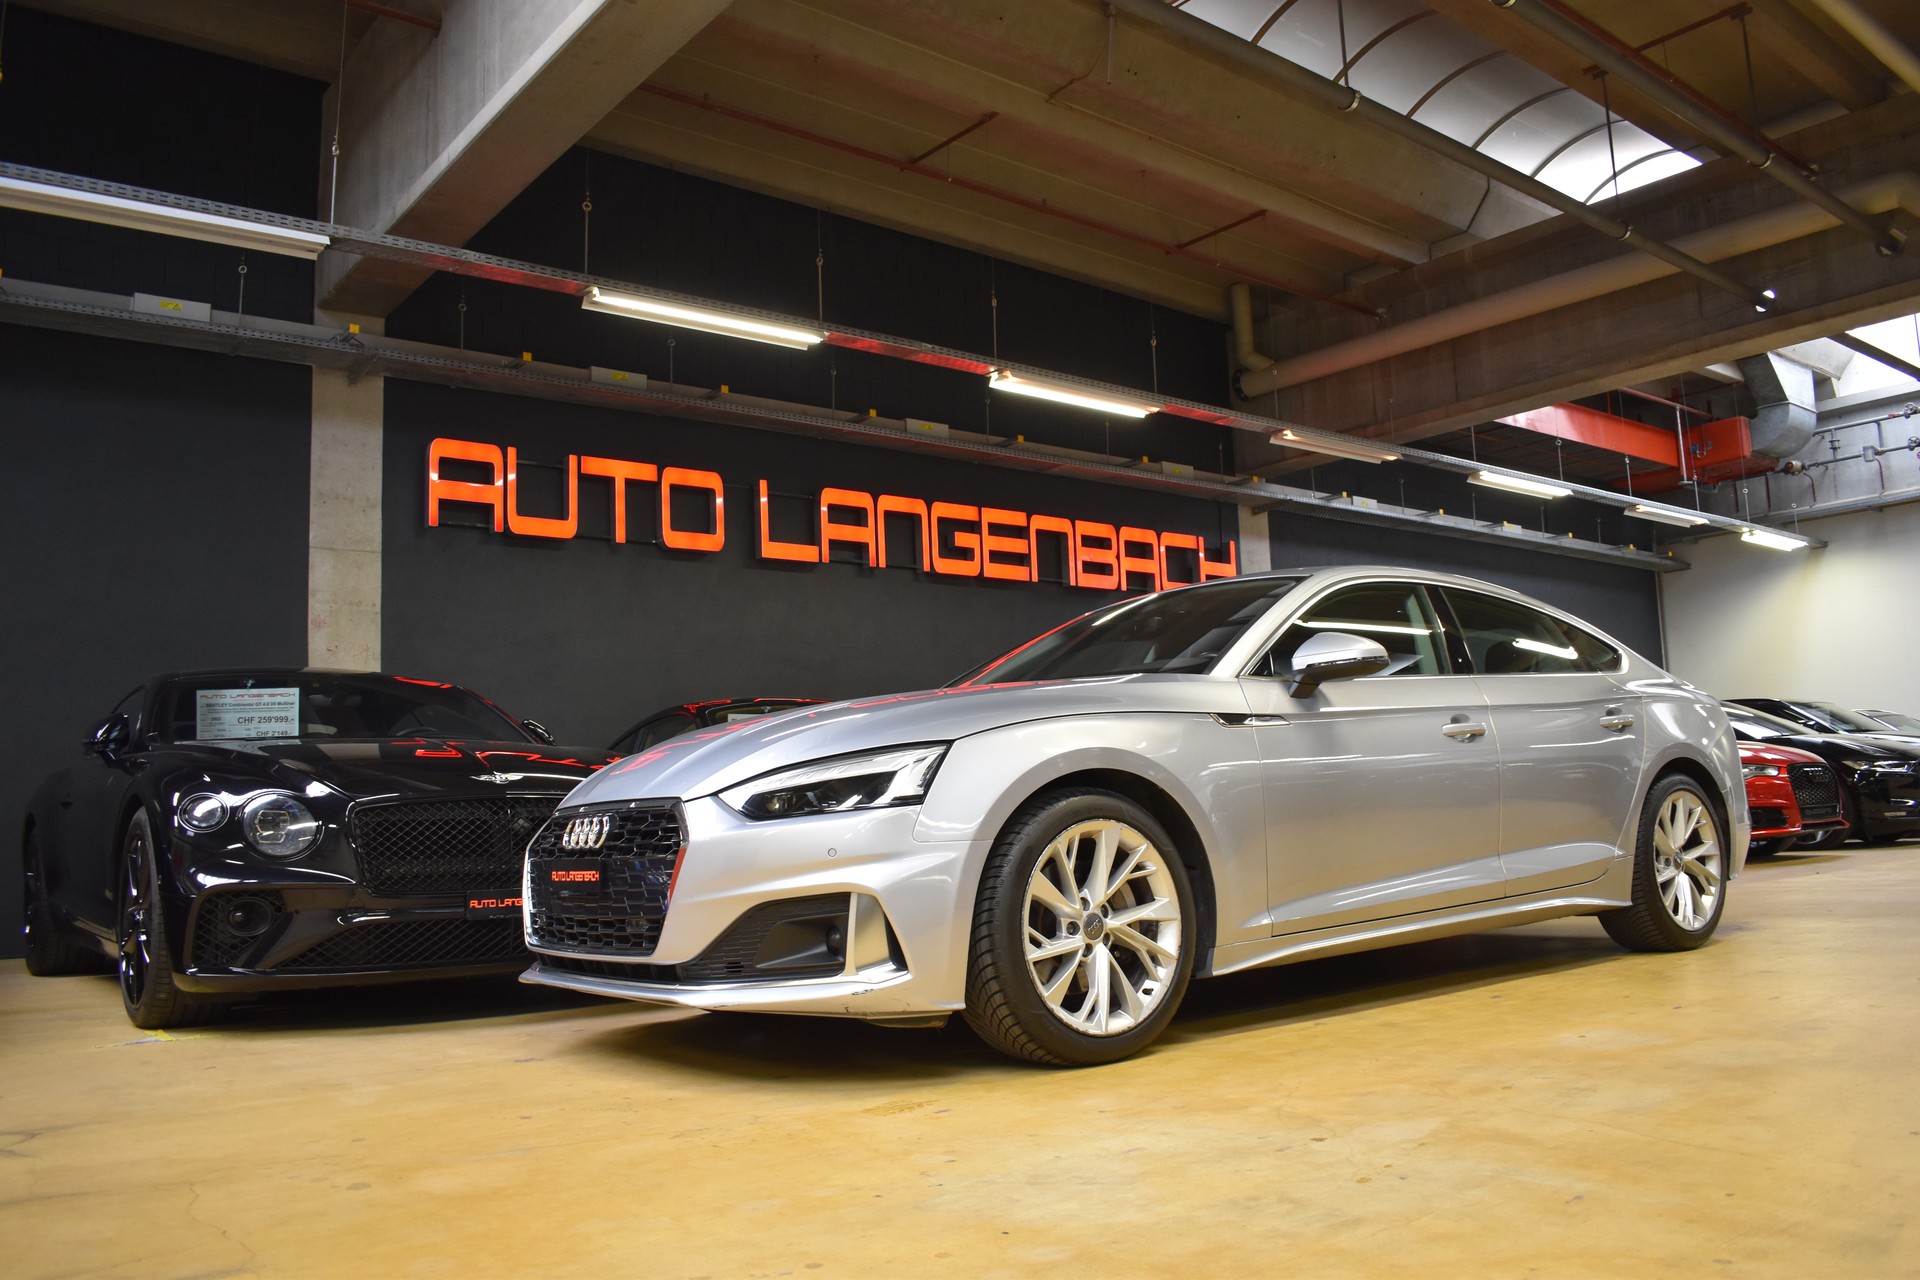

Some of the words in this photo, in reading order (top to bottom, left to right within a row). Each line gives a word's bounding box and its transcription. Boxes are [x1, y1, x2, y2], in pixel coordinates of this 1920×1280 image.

[427, 437, 724, 552] AUTO
[757, 479, 1236, 592] LANGENBACH
[237, 716, 255, 724] CHF
[552, 871, 566, 881] AUTO
[566, 871, 599, 881] LANGENBACH
[470, 899, 497, 908] AUTO
[498, 897, 523, 908] LANG
